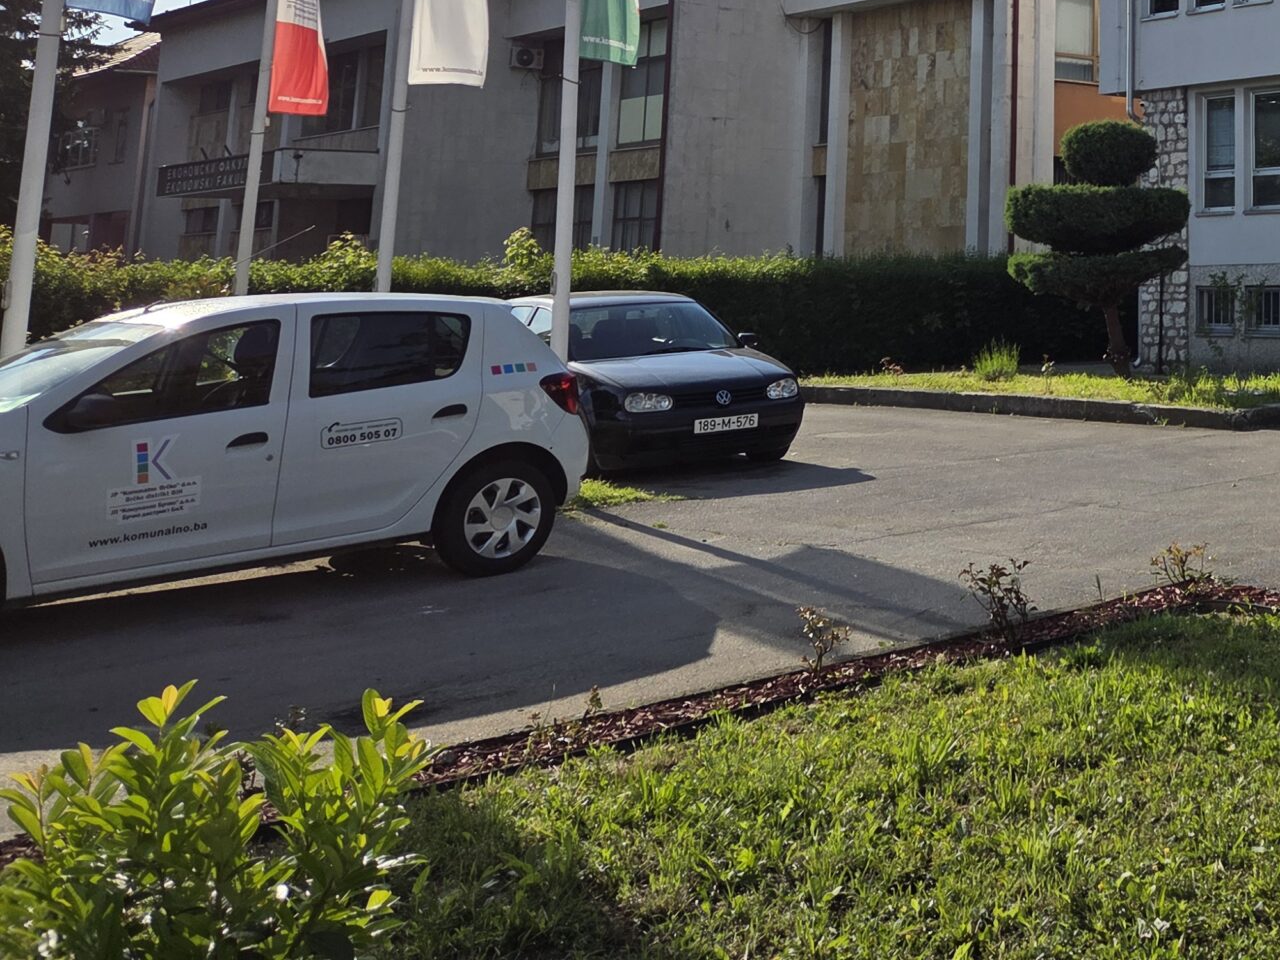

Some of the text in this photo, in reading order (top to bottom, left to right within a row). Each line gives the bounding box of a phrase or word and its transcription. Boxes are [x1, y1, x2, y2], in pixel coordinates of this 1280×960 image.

[216, 174, 244, 186] FAKUL
[698, 415, 755, 432] 189-M-576
[327, 428, 398, 446] 0800 505 07
[88, 522, 208, 548] www.komunalno.ba
